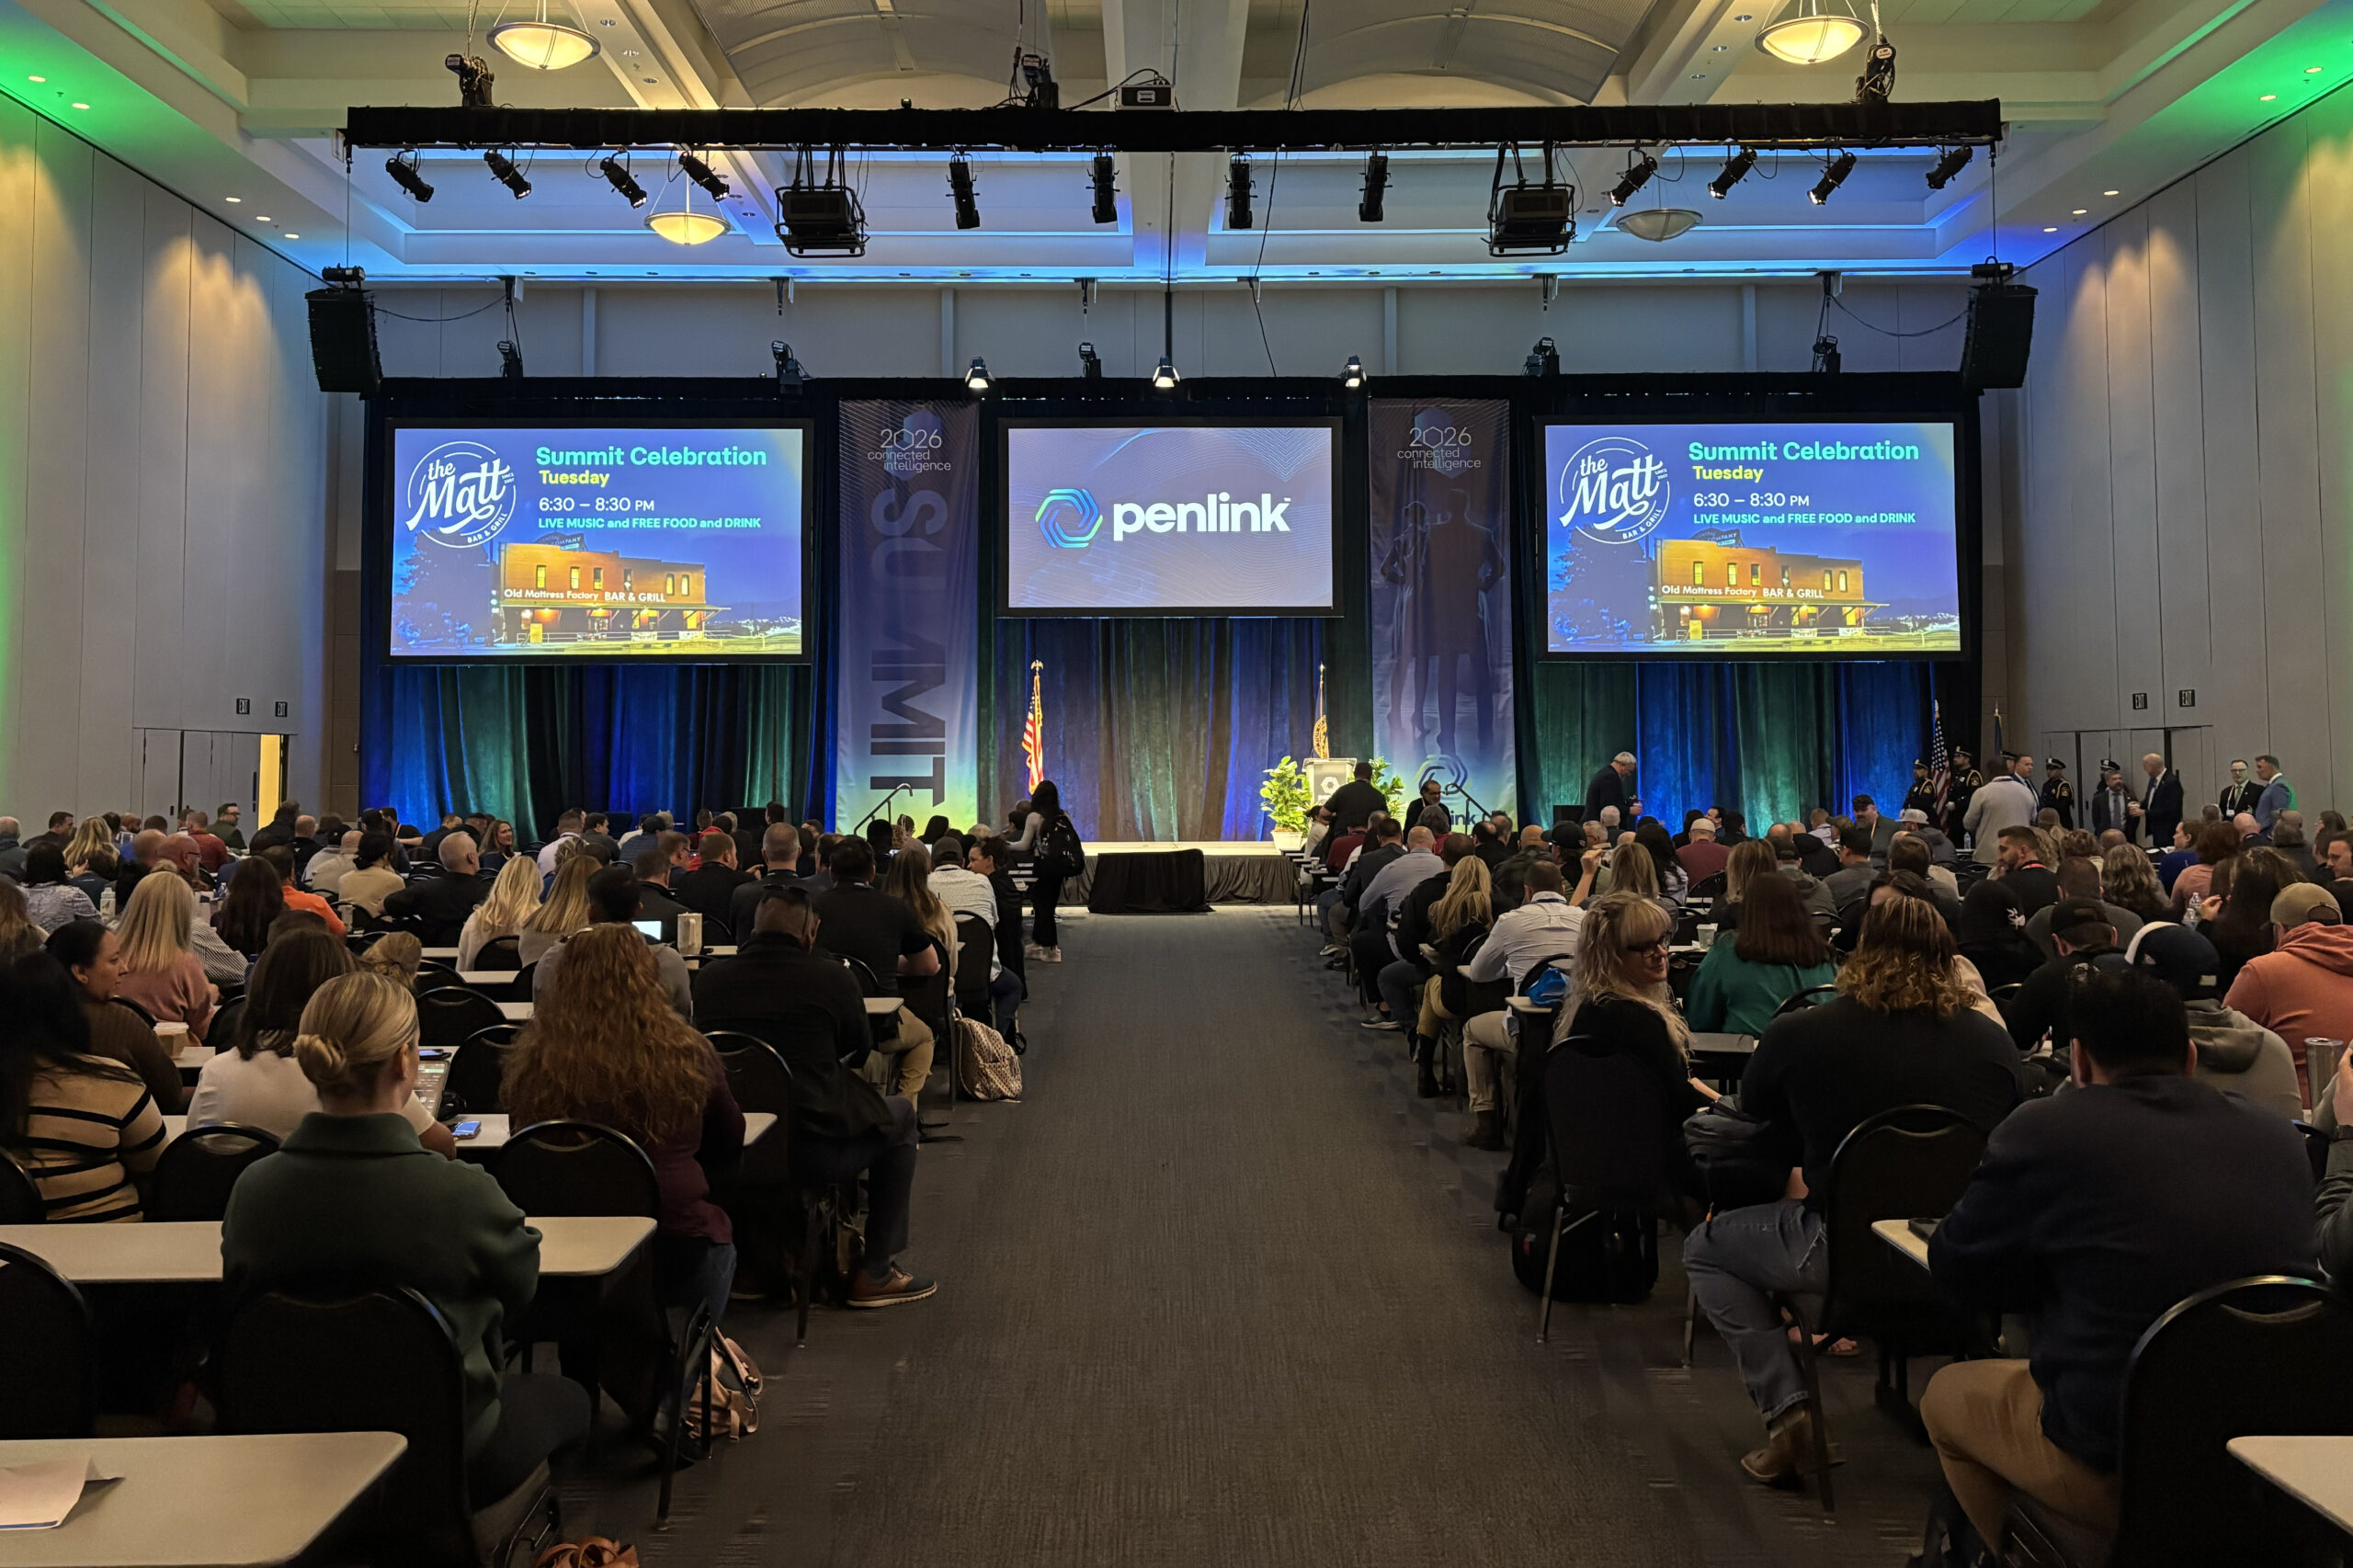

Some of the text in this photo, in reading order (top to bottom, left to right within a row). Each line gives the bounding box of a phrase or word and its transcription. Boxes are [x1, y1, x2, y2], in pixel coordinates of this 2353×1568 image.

[536, 446, 767, 465] Summit Celebration
[868, 449, 929, 460] connected
[1397, 448, 1460, 459] connected
[1689, 440, 1919, 460] Summit Celebration
[428, 460, 456, 481] the
[883, 460, 951, 472] intelligence
[1413, 457, 1481, 472] intelligence
[1580, 455, 1608, 476] the
[540, 470, 609, 487] Tuesday
[1693, 466, 1764, 483] Tuesday
[405, 458, 510, 534] Matt
[1559, 454, 1664, 529] Matt
[1693, 493, 1729, 507] 6:30
[1750, 493, 1785, 506] 8:30
[1790, 495, 1810, 506] PM
[539, 498, 574, 511] 6:30
[596, 498, 631, 511] 8:30
[635, 500, 654, 511] PM
[539, 518, 761, 528] LIVE MUSIC and FREE FOOD and DRINK
[1113, 492, 1290, 541] penlink
[1622, 530, 1638, 540] BAR
[1646, 508, 1662, 528] GRILL
[1693, 514, 1915, 524] LIVE MUSIC and FREE FOOD and DRINK
[467, 535, 483, 543] BAR
[490, 513, 507, 530] GRILL
[504, 588, 666, 602] Old Mattress Factory BAR & GRILL
[1662, 585, 1824, 598] Old Mattress Factory BAR & GRILL
